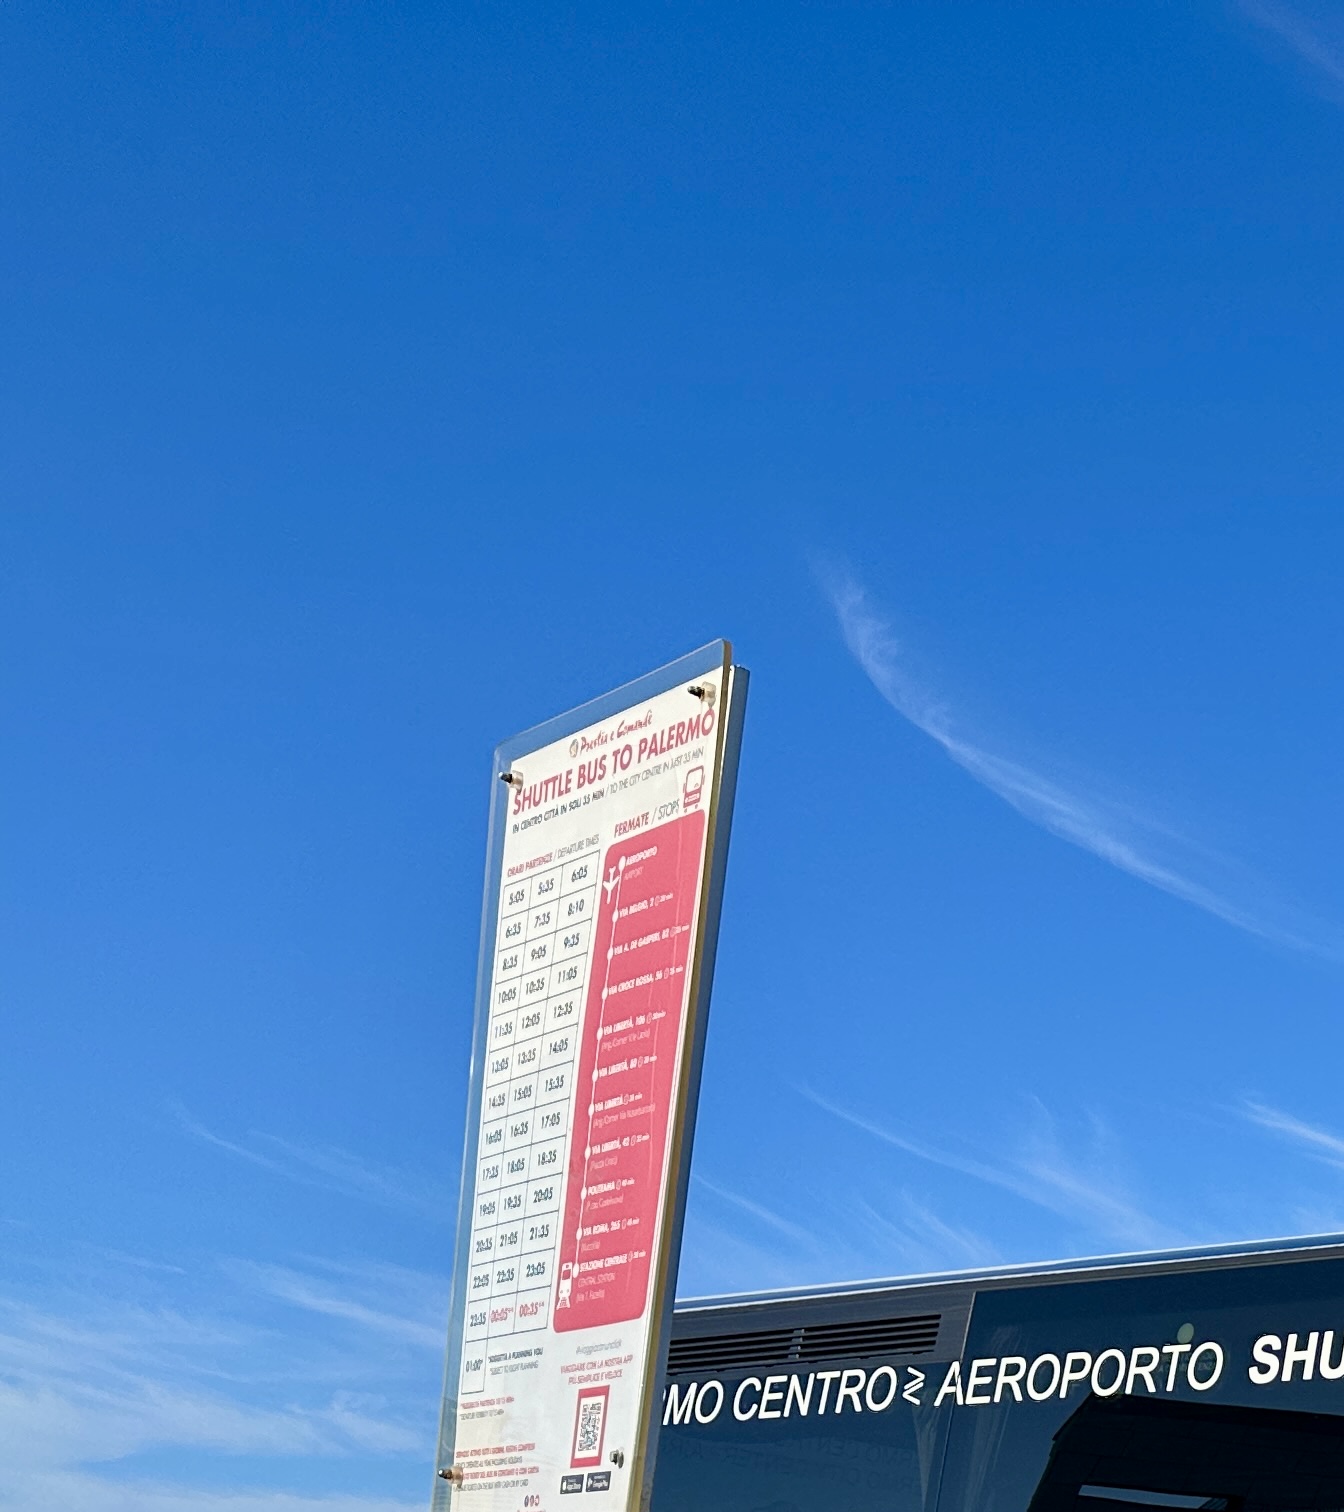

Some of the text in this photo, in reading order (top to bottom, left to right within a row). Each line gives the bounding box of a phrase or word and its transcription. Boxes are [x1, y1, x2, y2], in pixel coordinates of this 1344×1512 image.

[580, 731, 607, 753] Prestia
[513, 708, 715, 815] SHUTTLE BUS TO PALERMO
[513, 824, 519, 834] IN
[521, 814, 542, 830] CENTRO
[560, 804, 567, 814] IN
[583, 794, 590, 805] 35
[610, 782, 617, 794] TO
[619, 778, 628, 790] THE
[629, 773, 641, 786] CITY
[642, 764, 661, 781] CENTRE
[663, 762, 669, 772] IN
[683, 751, 691, 764] 35
[692, 746, 704, 760] MIN
[614, 798, 679, 837] FERMATE STOPS
[557, 840, 584, 859] DEPARTURE
[625, 846, 657, 866] AEROPORTO
[571, 865, 587, 882] 6:05
[538, 878, 554, 895] 5:35
[509, 889, 524, 905] 5:05
[568, 899, 584, 916] 8:10
[534, 911, 550, 928] 7:35
[505, 922, 521, 938] 6:35
[564, 933, 580, 948] 9:35
[531, 945, 546, 960] 9:05
[502, 955, 518, 971] 8:35
[558, 966, 577, 983] 11:05
[526, 977, 544, 994] 10:35
[498, 987, 516, 1004] 10:05
[554, 1001, 573, 1018] 12:35
[522, 1012, 540, 1029] 12:05
[495, 1022, 512, 1038] 11:35
[549, 1038, 568, 1055] 14:05
[518, 1048, 536, 1065] 13:35
[545, 1075, 564, 1092] 15:35
[514, 1085, 532, 1101] 15:05
[542, 1112, 560, 1128] 17:05
[511, 1121, 528, 1137] 16:35
[507, 1158, 525, 1174] 18:05
[538, 1149, 556, 1166] 18:35
[504, 1195, 521, 1210] 19:35
[533, 1187, 553, 1203] 20:05
[500, 1231, 518, 1247] 21:05
[529, 1224, 549, 1240] 21:35
[497, 1268, 514, 1283] 22:35
[526, 1262, 545, 1277] 23:05
[734, 1366, 898, 1421] CENTRO
[934, 1342, 1224, 1407] AEROPORTO
